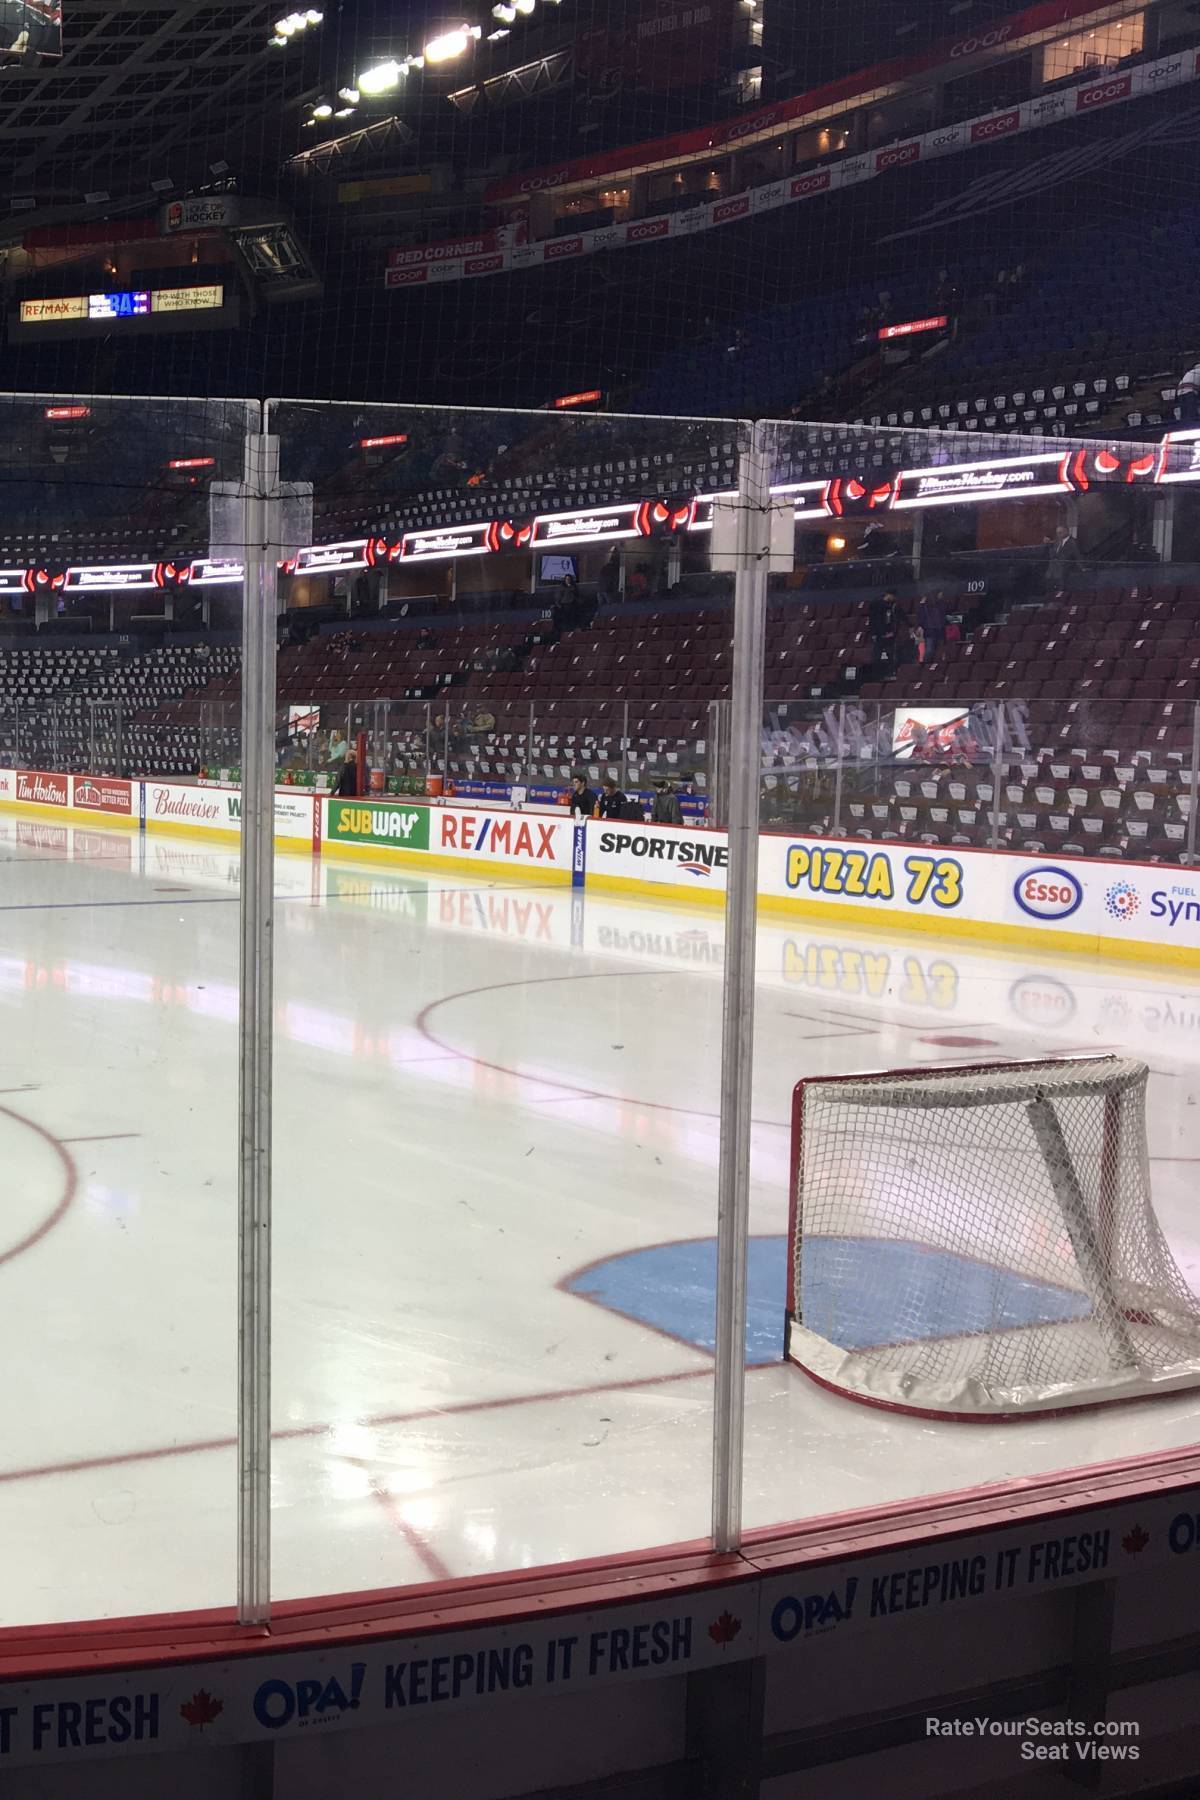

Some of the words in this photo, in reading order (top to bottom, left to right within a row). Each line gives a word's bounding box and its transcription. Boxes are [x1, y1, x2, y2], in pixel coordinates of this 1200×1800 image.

[951, 26, 1010, 57] CO-OP
[1083, 83, 1125, 104] CO-OP
[977, 117, 1014, 137] CO-OP
[880, 148, 915, 166] CO-OP
[794, 175, 827, 192] CO-OP
[185, 211, 227, 223] HOCKEY
[631, 223, 665, 237] CO-OP
[396, 250, 423, 265] RED
[425, 241, 484, 260] CORNER
[549, 241, 579, 256] CO-OP
[193, 289, 217, 298] THOSE
[967, 580, 985, 591] 109
[541, 609, 552, 618] 110
[17, 775, 32, 799] Tim
[33, 776, 66, 803] Hortons
[152, 788, 220, 819] Budweiser
[337, 808, 420, 838] SUBWAY
[441, 814, 557, 860] RE/MAX
[575, 829, 583, 866] WINMAR
[600, 832, 728, 867] SPORTSNE
[785, 844, 895, 901] PIZZA
[904, 855, 964, 909] 73
[1024, 878, 1072, 904] Esso
[1172, 886, 1196, 897] FUEL
[1151, 890, 1200, 926] Syn
[770, 1576, 858, 1643] OPA!
[870, 1555, 985, 1618] KEEPING
[995, 1548, 1021, 1591] IT
[1028, 1530, 1110, 1583] FRESH
[253, 1662, 367, 1729] OPA!
[385, 1643, 533, 1709] KEEPING
[546, 1636, 578, 1682] IT
[590, 1616, 692, 1675] FRESH
[33, 1693, 159, 1750] FRESH
